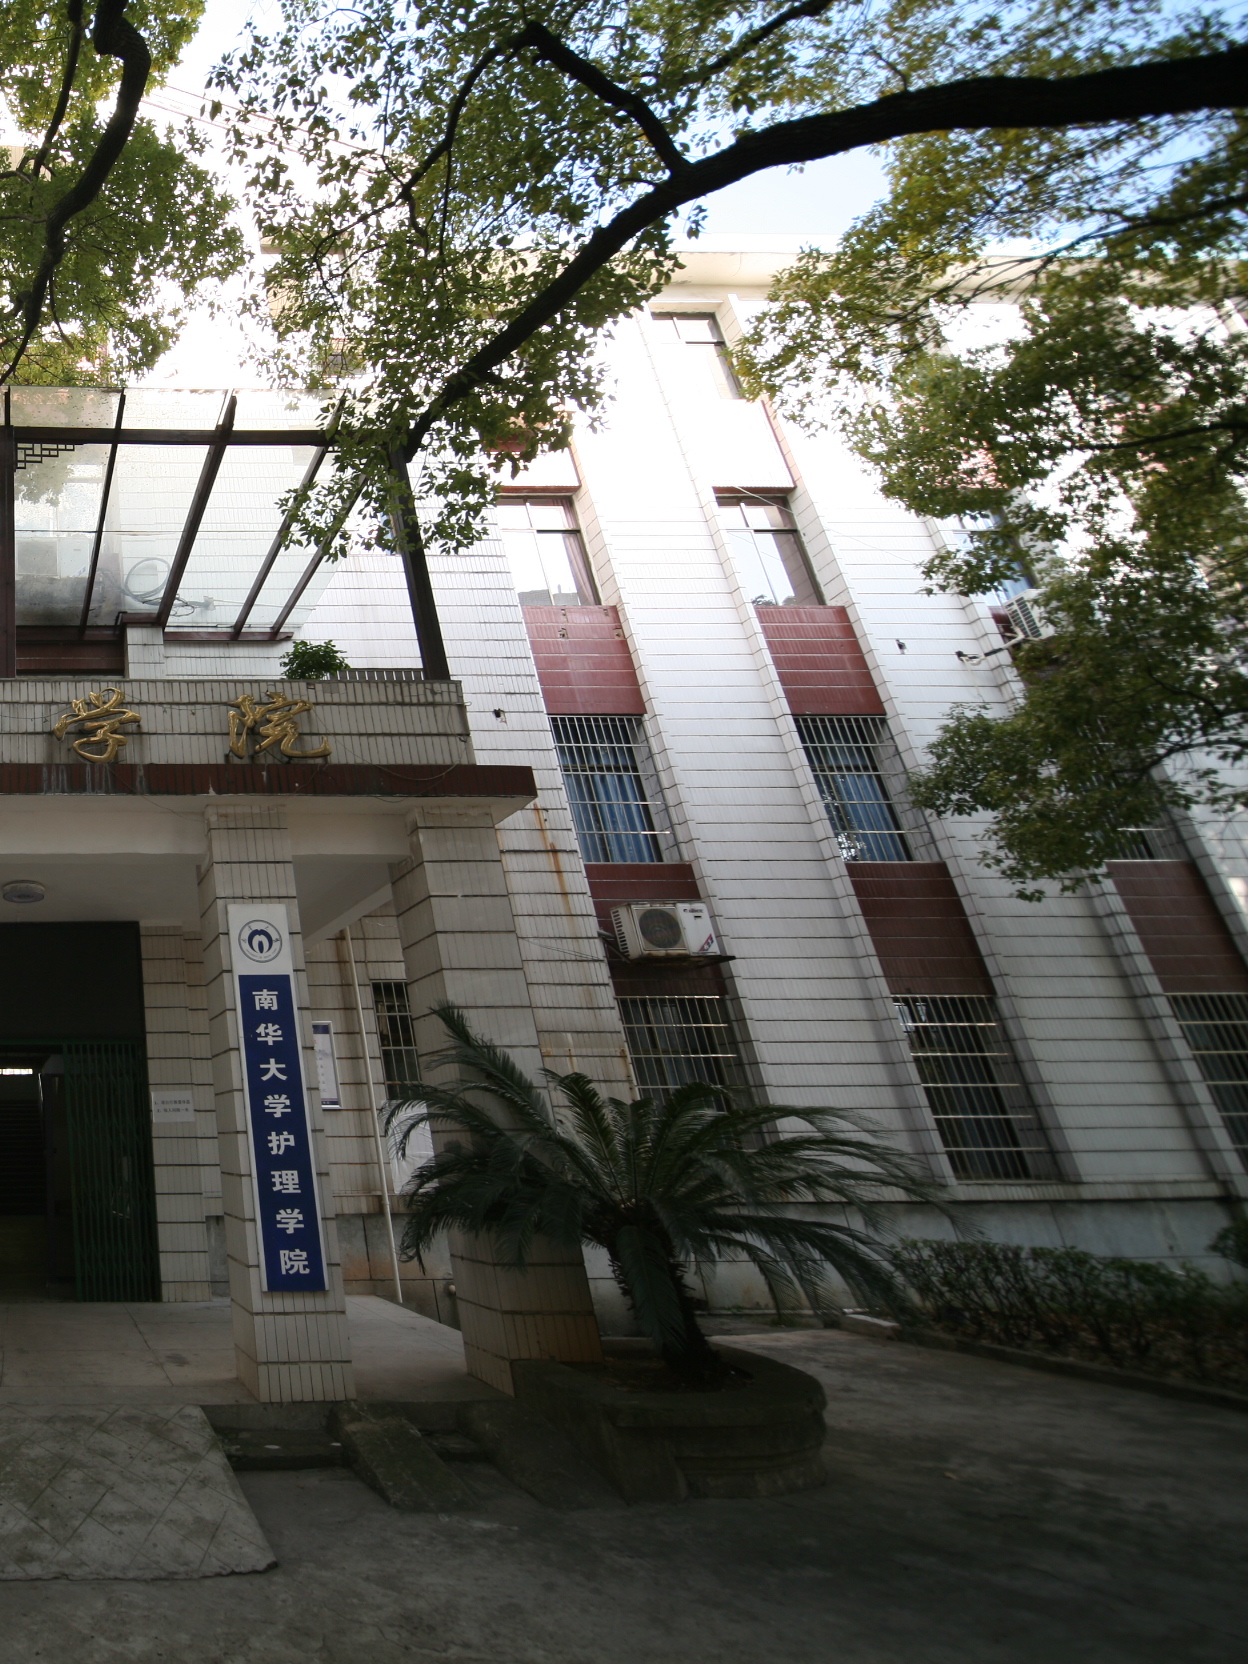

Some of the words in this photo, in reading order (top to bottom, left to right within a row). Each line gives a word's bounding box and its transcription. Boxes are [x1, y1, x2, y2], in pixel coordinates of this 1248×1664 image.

[252, 988, 311, 1275] 南华大学护理学院
